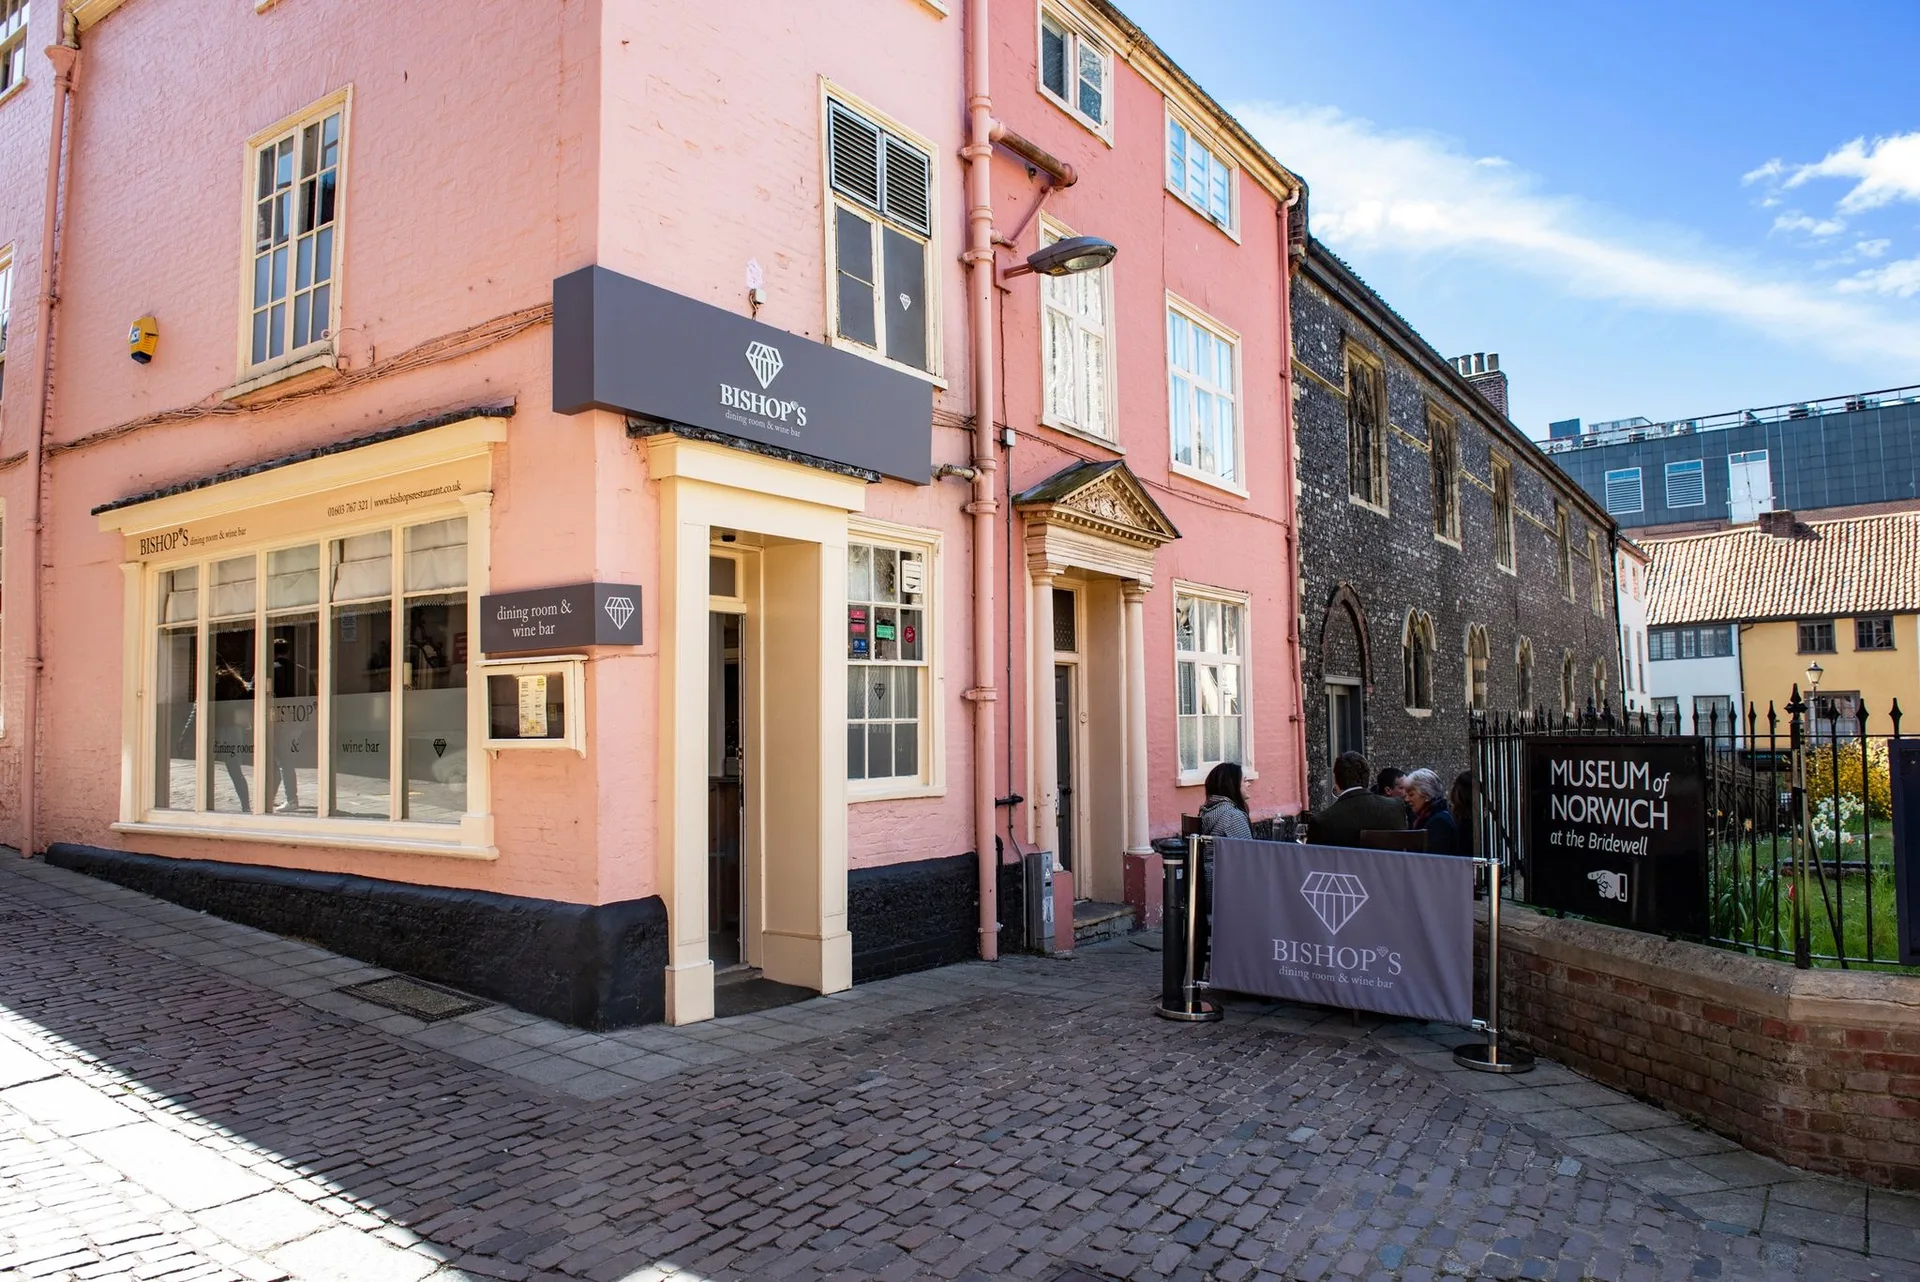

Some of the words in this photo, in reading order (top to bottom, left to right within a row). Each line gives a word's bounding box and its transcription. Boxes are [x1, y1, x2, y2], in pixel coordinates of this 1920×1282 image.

[720, 383, 807, 427] BISHOP'S
[725, 409, 748, 426] dining
[748, 418, 766, 429] room
[766, 420, 774, 430] &
[775, 424, 790, 435] wine
[790, 427, 801, 438] bar
[327, 505, 345, 517] 01603
[346, 502, 357, 514] 767
[358, 499, 369, 511] 321
[373, 480, 462, 508] www.bishopsrestaurant.co.uk
[140, 528, 189, 556] BISHOP'S
[190, 536, 205, 546] dining
[206, 534, 218, 543] room
[218, 530, 225, 540] &
[225, 529, 238, 538] wine
[238, 527, 247, 536] bar
[496, 606, 529, 623] dining
[531, 605, 558, 617] room
[560, 598, 573, 614] &
[512, 624, 537, 638] wine
[538, 620, 556, 636] bar
[290, 738, 300, 753] &
[342, 740, 364, 753] wine
[365, 738, 380, 753] bar
[1551, 759, 1650, 791] MUSEUM
[1652, 772, 1671, 799] of
[1551, 794, 1669, 830] NORWICH
[1550, 830, 1563, 845] at
[1566, 829, 1585, 848] the
[1588, 832, 1648, 856] Bridewell
[1272, 938, 1402, 976] BISHOP'S
[1278, 965, 1310, 981] dining
[1312, 972, 1336, 982] room
[1338, 972, 1350, 983] &
[1351, 975, 1375, 986] wine
[1377, 976, 1394, 989] bar
